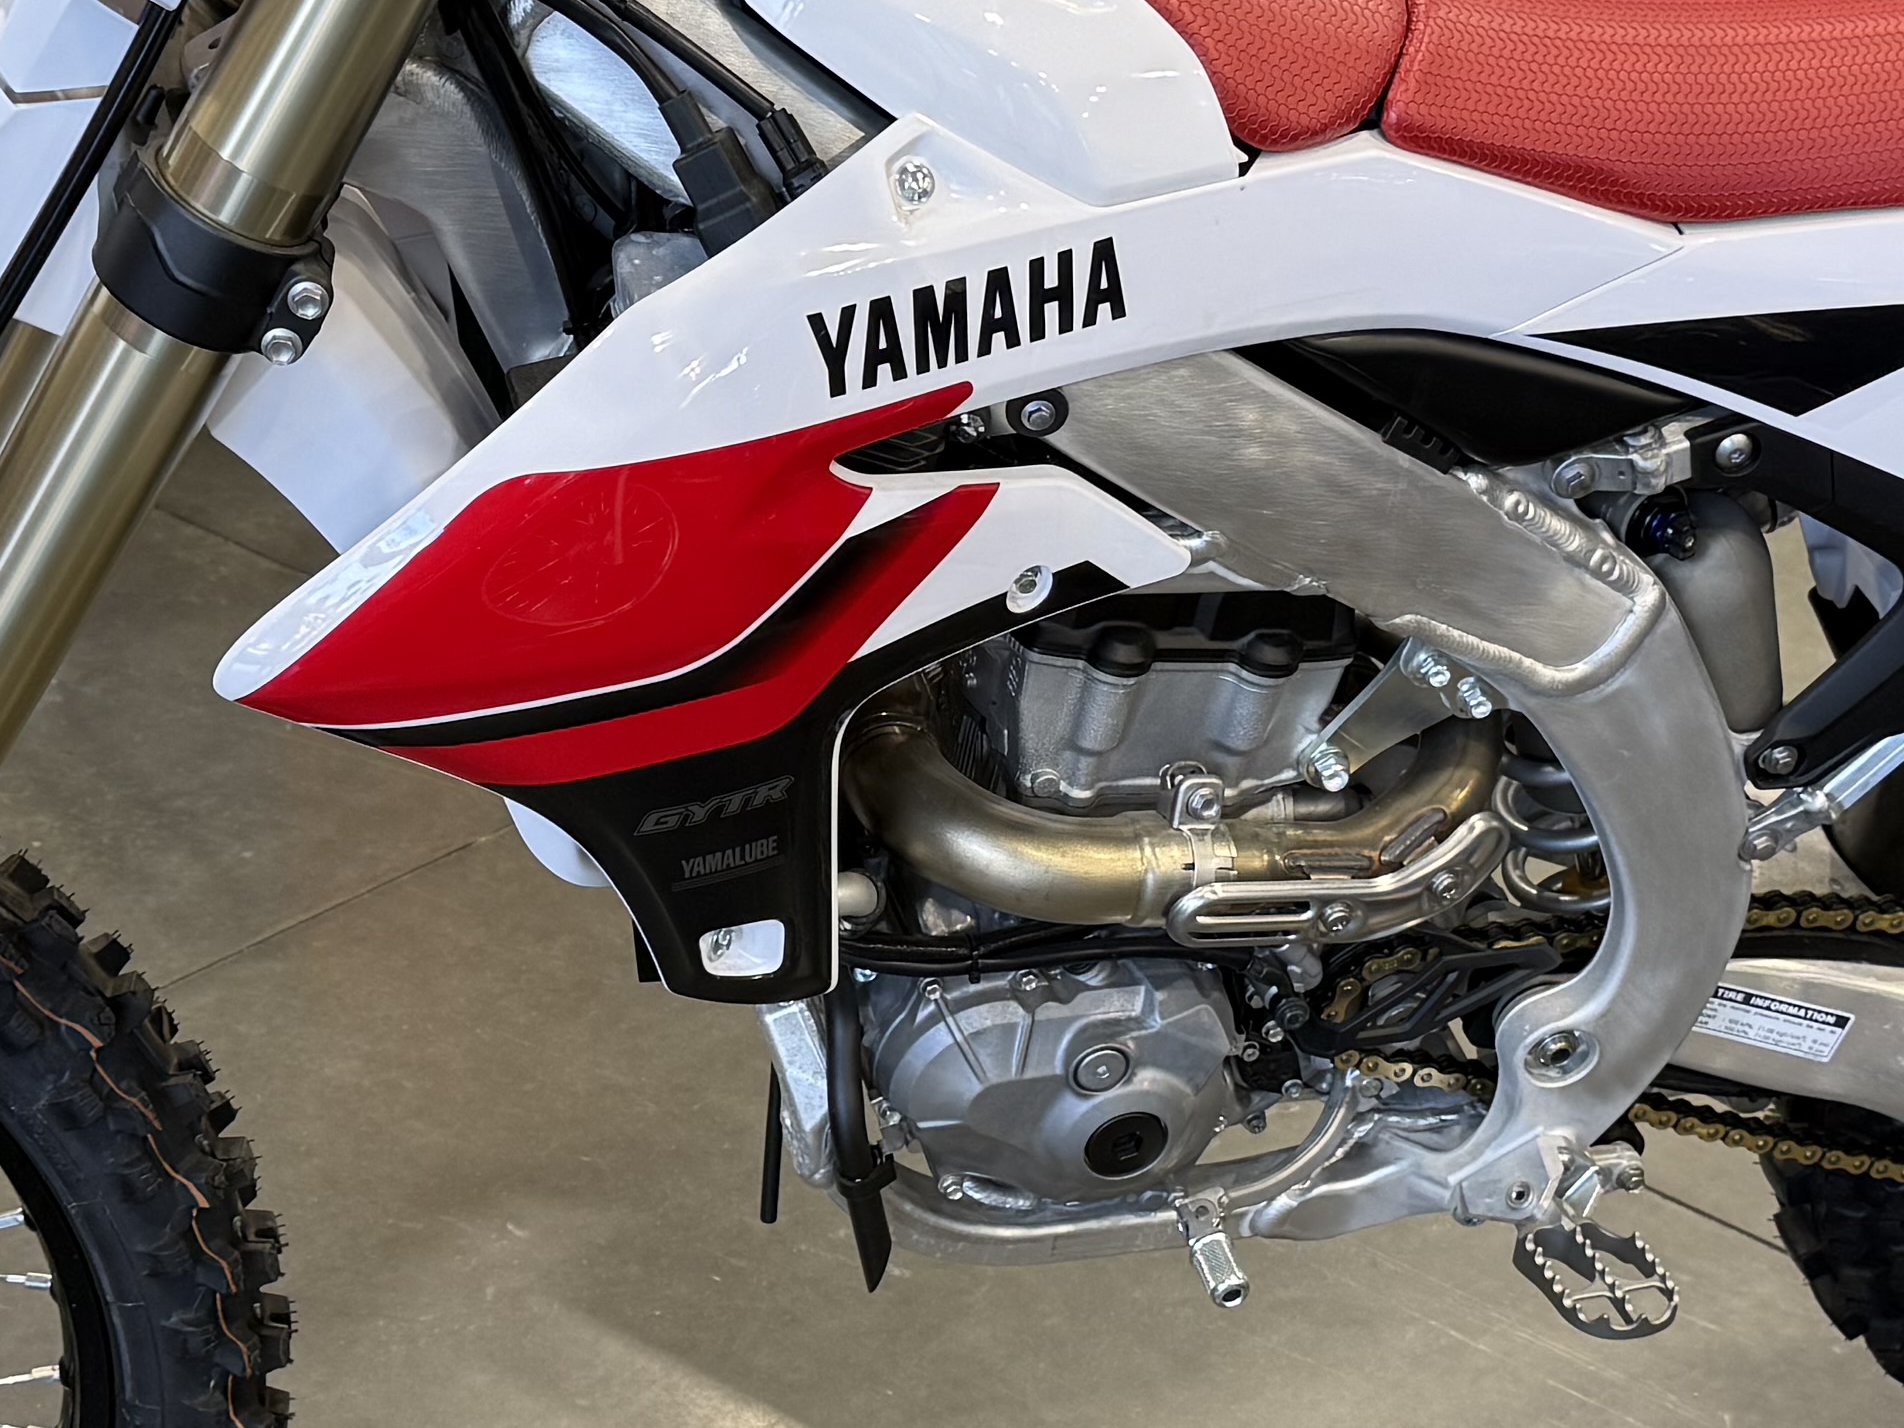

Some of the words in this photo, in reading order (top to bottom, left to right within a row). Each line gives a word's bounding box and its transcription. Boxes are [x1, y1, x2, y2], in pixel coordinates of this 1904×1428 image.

[805, 236, 1129, 399] YAMAHA
[634, 775, 794, 836] GYTR
[681, 836, 779, 879] YAMALUBE
[1717, 988, 1746, 1002] TIRE
[1749, 996, 1837, 1025] INFORMATION
